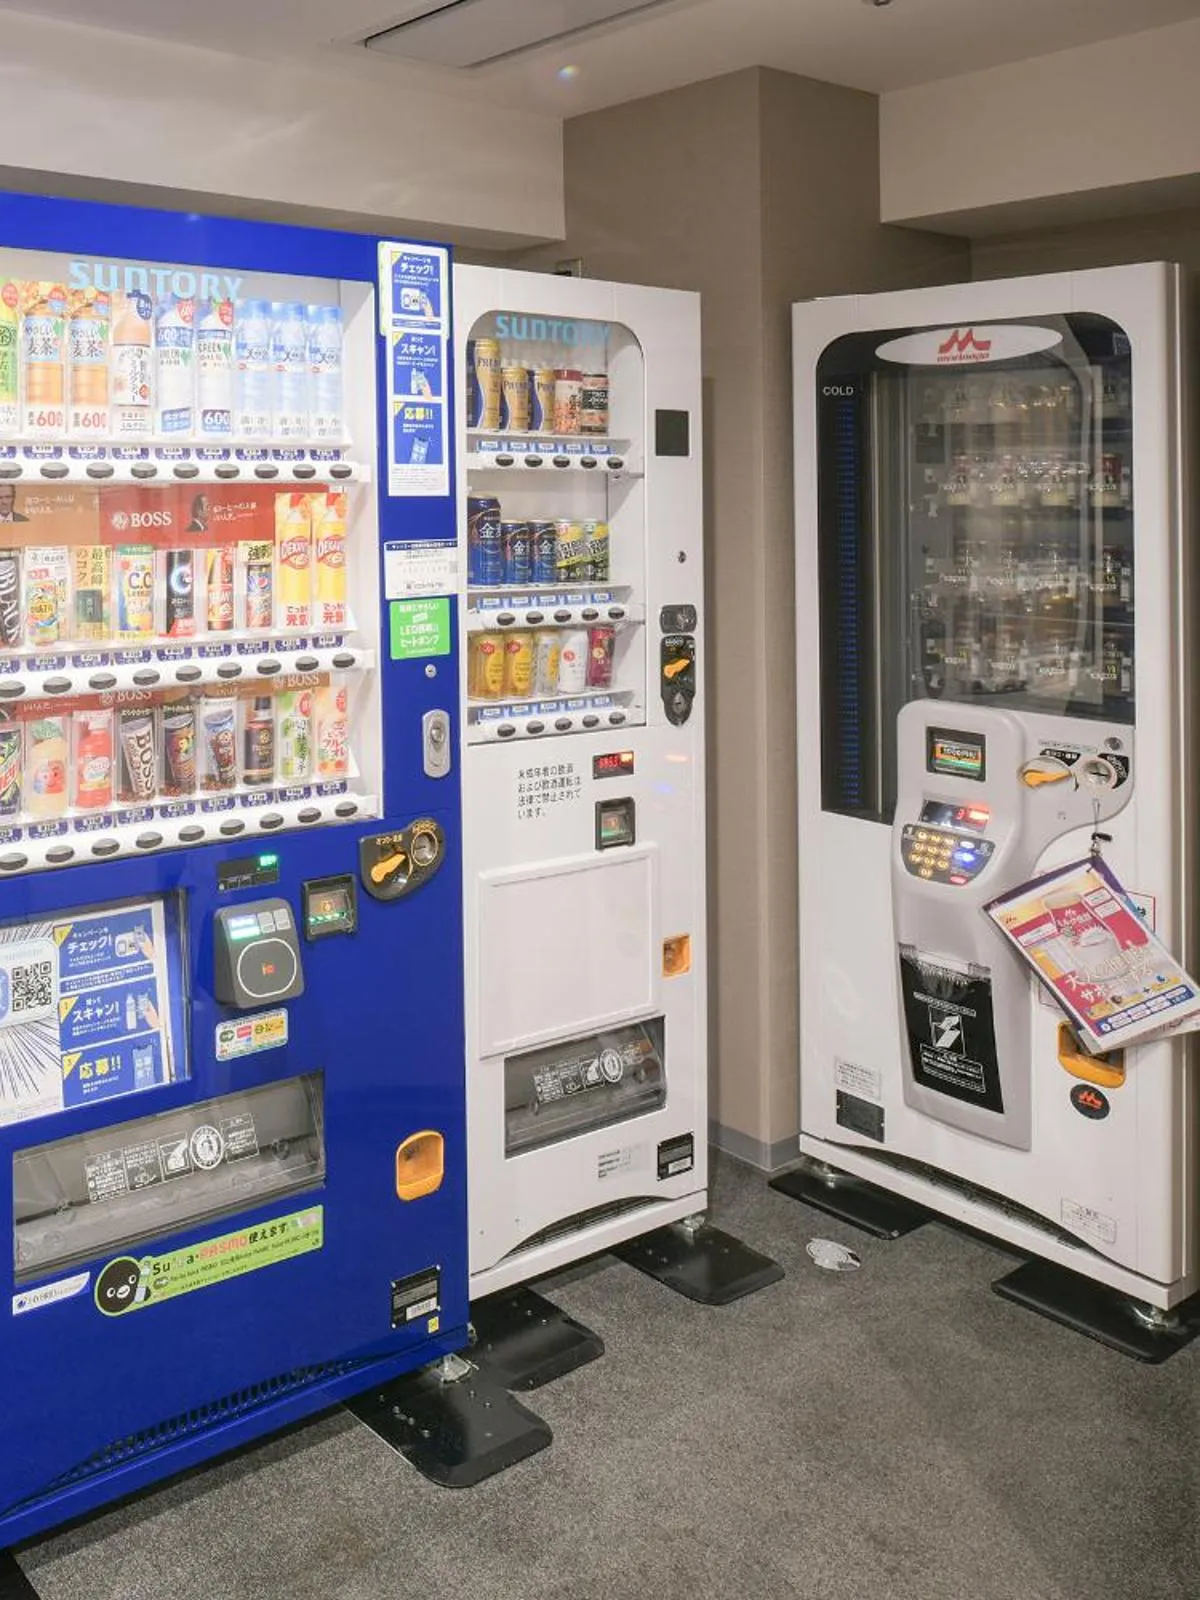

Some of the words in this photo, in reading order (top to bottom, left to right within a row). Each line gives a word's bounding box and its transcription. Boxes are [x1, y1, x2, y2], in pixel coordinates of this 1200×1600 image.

[68, 259, 244, 299] SUNTORY
[822, 385, 855, 397] COLD
[130, 511, 173, 528] BOSS
